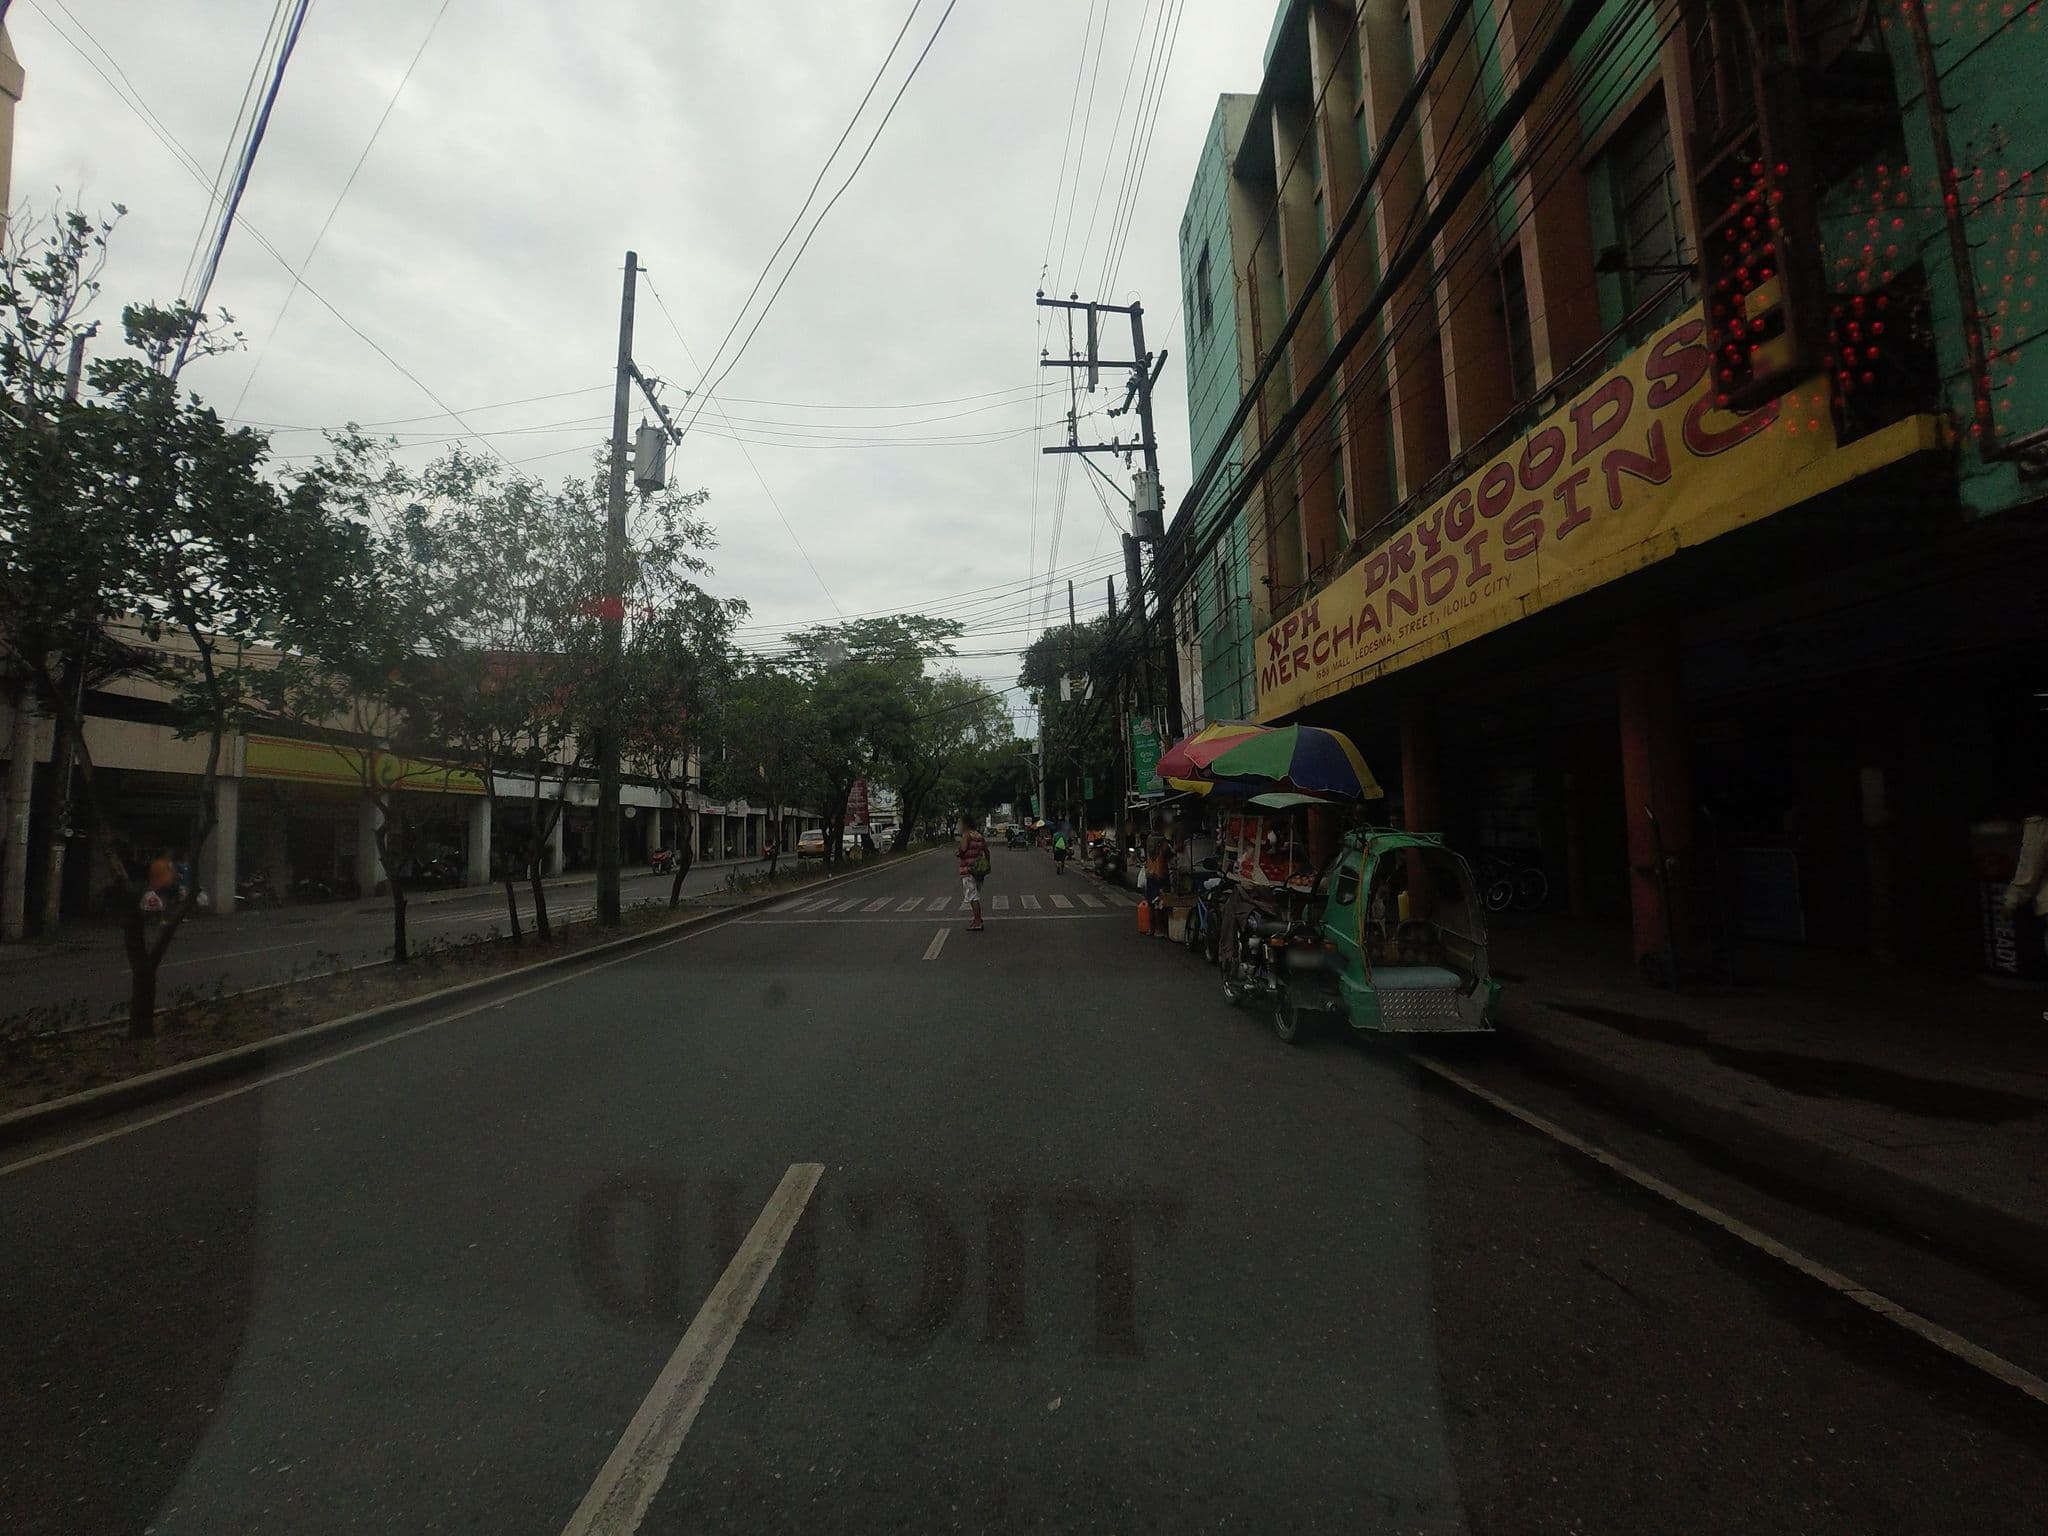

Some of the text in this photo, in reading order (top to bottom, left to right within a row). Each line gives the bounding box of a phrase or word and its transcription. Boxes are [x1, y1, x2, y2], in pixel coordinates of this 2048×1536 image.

[1363, 320, 1708, 597] DRYGOODS
[1442, 592, 1477, 618] ILOILO
[1485, 573, 1513, 597] CITY
